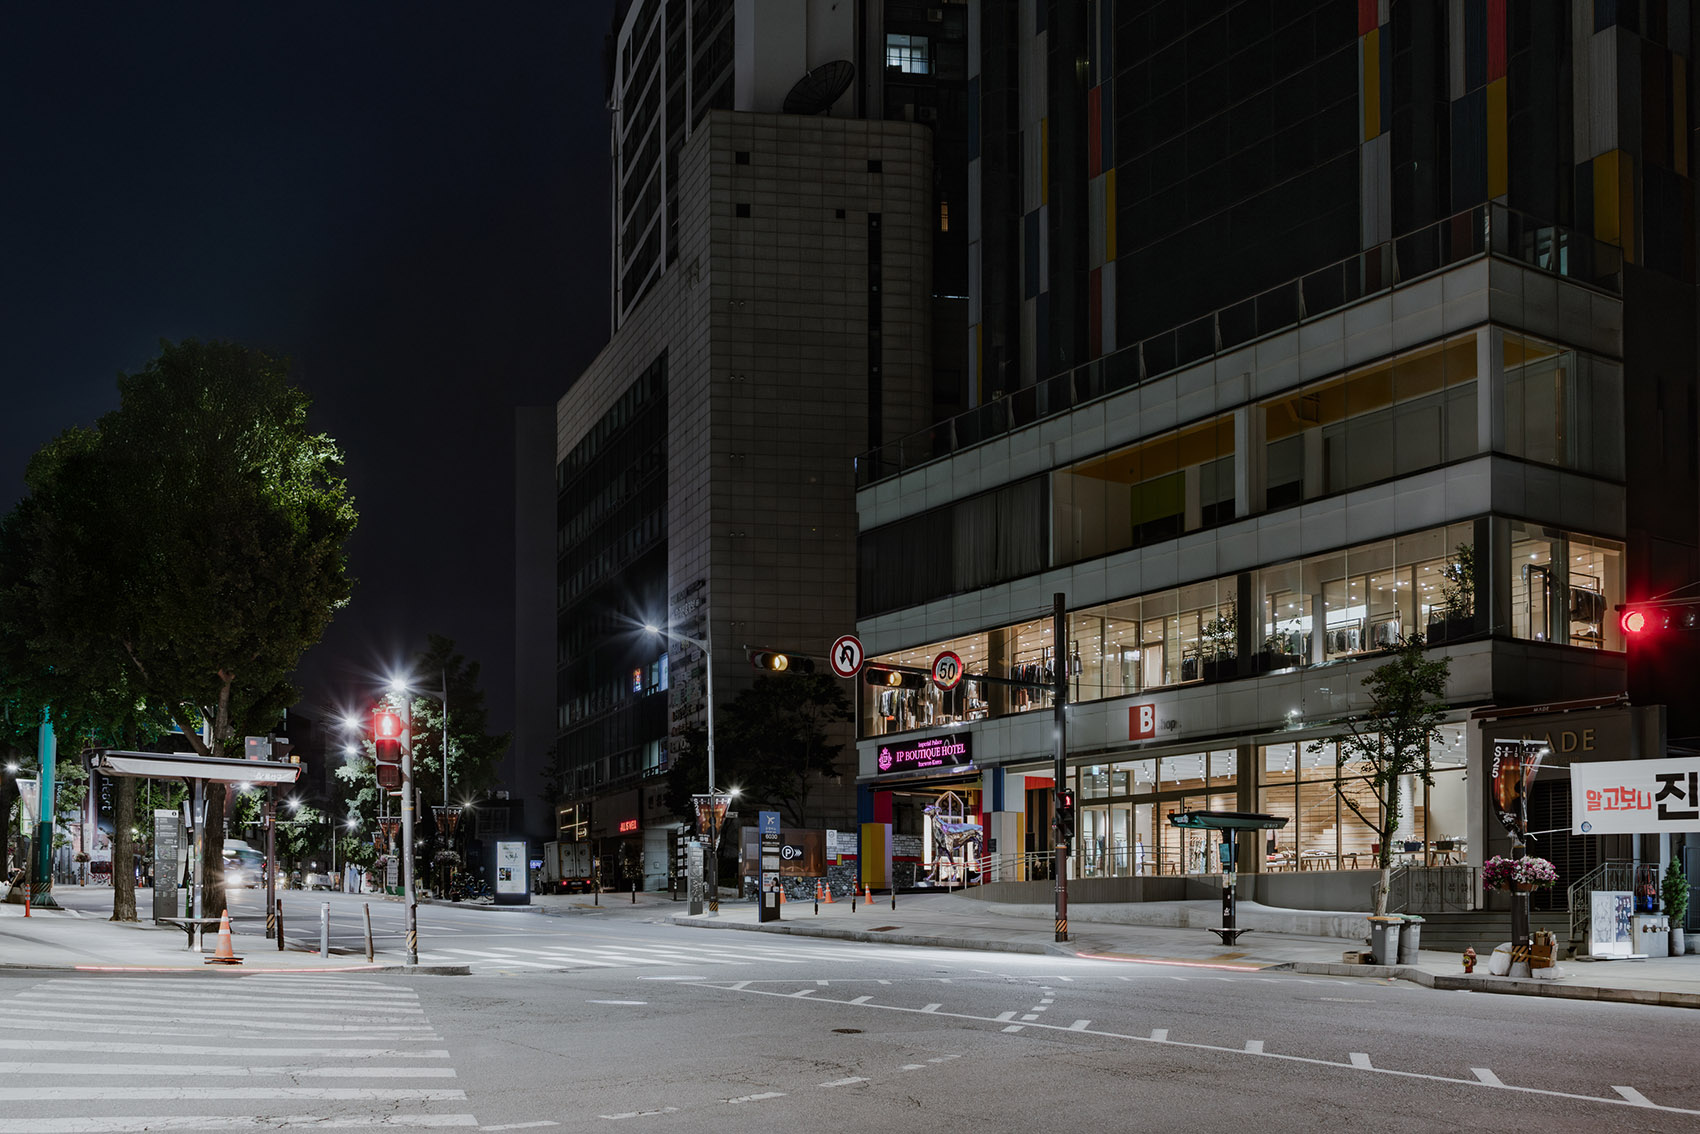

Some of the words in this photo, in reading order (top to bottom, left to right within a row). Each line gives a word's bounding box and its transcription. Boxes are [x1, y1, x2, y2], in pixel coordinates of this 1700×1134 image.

[939, 662, 955, 680] 50
[1140, 706, 1153, 733] B
[896, 751, 904, 762] IP
[905, 747, 941, 761] BOUTIQUE
[941, 743, 966, 756] HOTEL
[1586, 785, 1652, 812] 알고보니
[1655, 771, 1699, 820] 진
